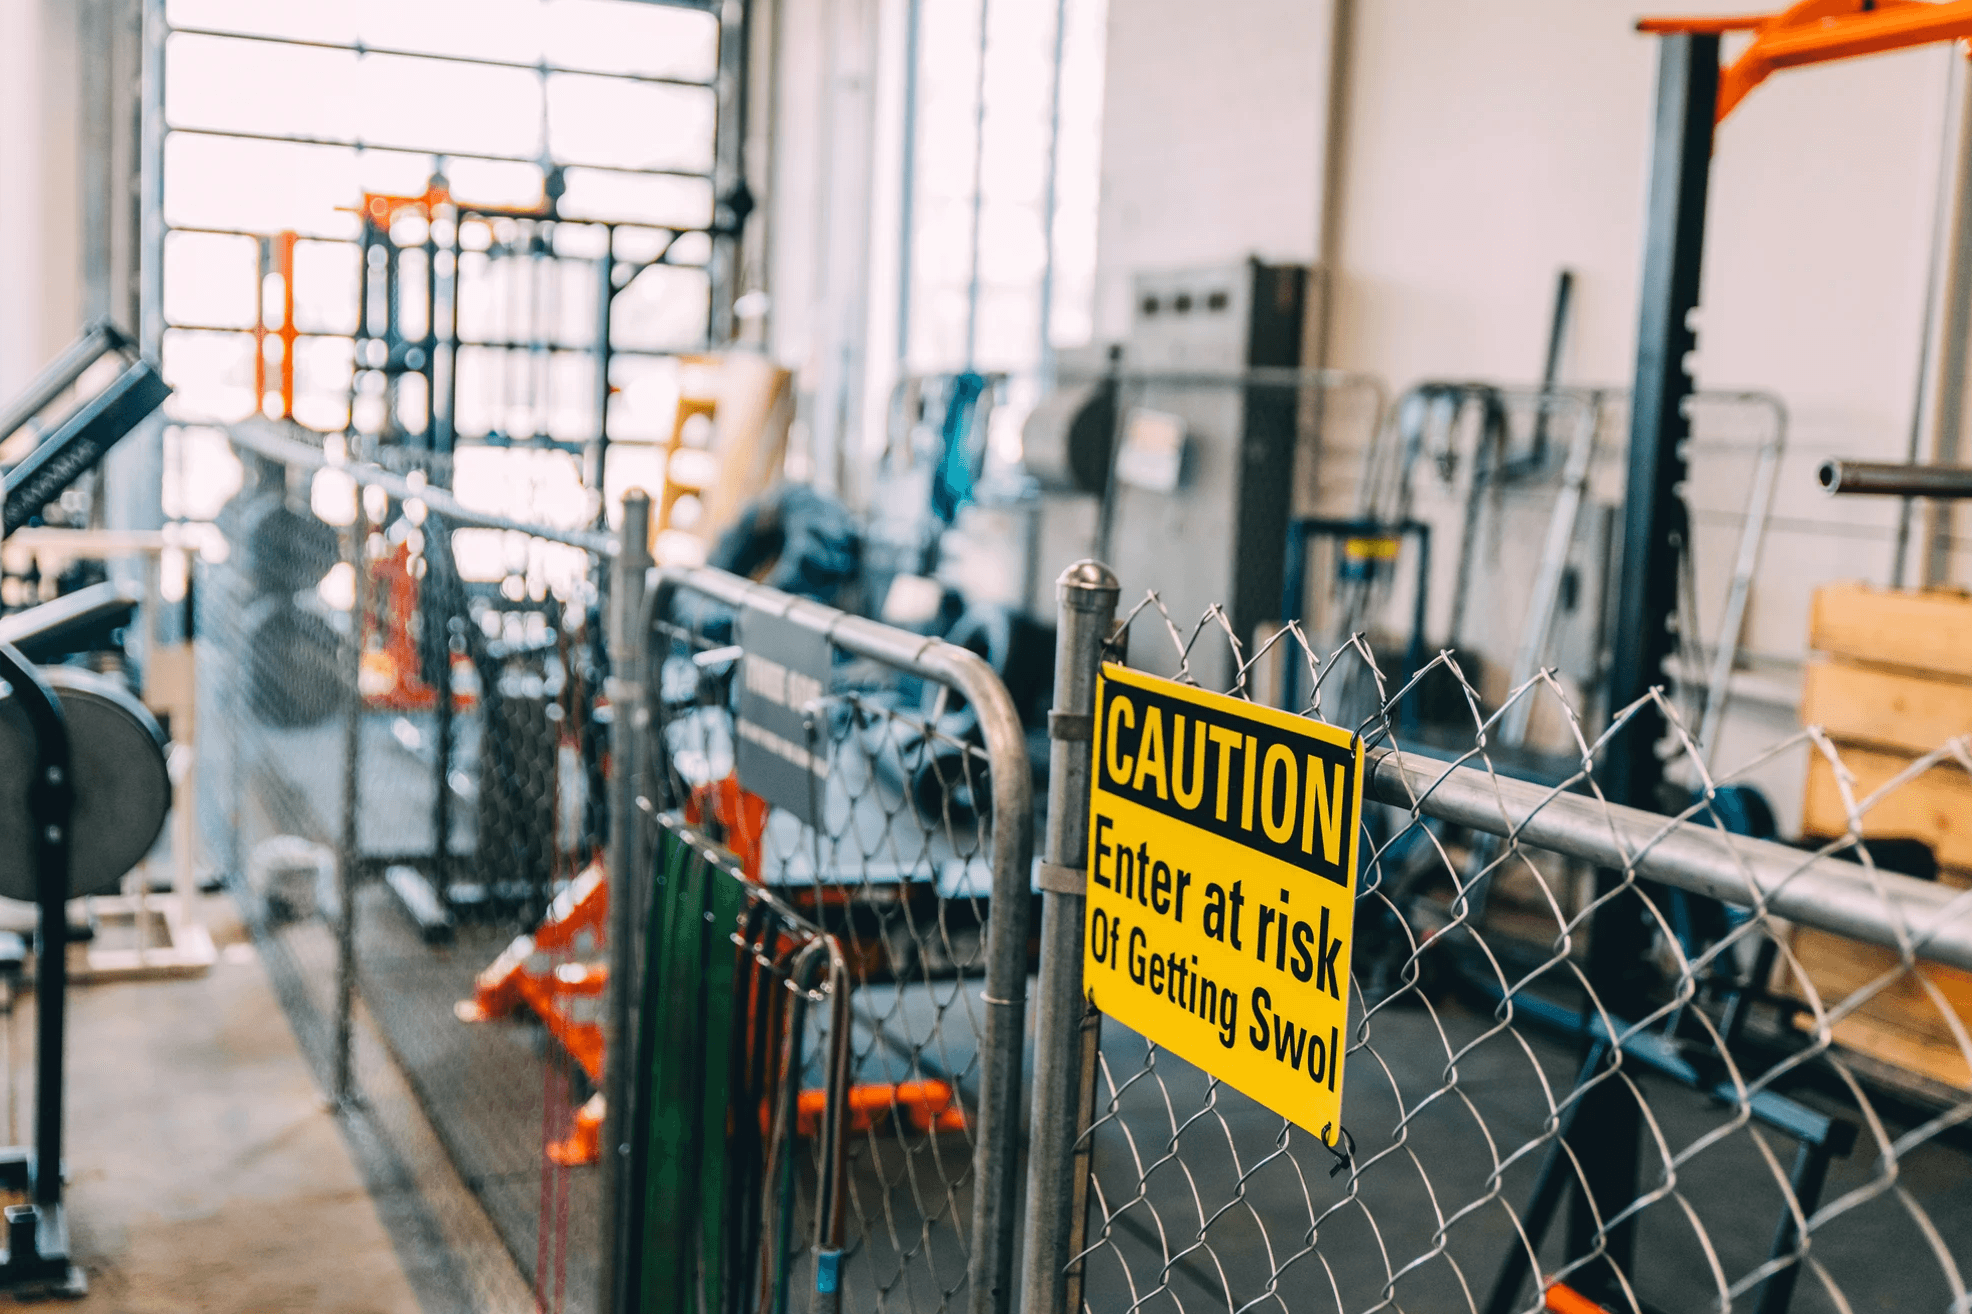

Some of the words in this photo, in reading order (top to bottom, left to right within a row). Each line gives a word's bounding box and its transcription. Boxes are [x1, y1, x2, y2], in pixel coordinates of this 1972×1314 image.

[1106, 695, 1345, 866] CAUTION
[1091, 907, 1119, 971] Of
[1129, 927, 1238, 1049] Getting
[1250, 987, 1338, 1092] Swol
[1094, 813, 1190, 922] Enter
[1203, 880, 1244, 950] at
[1257, 888, 1342, 1001] risk
